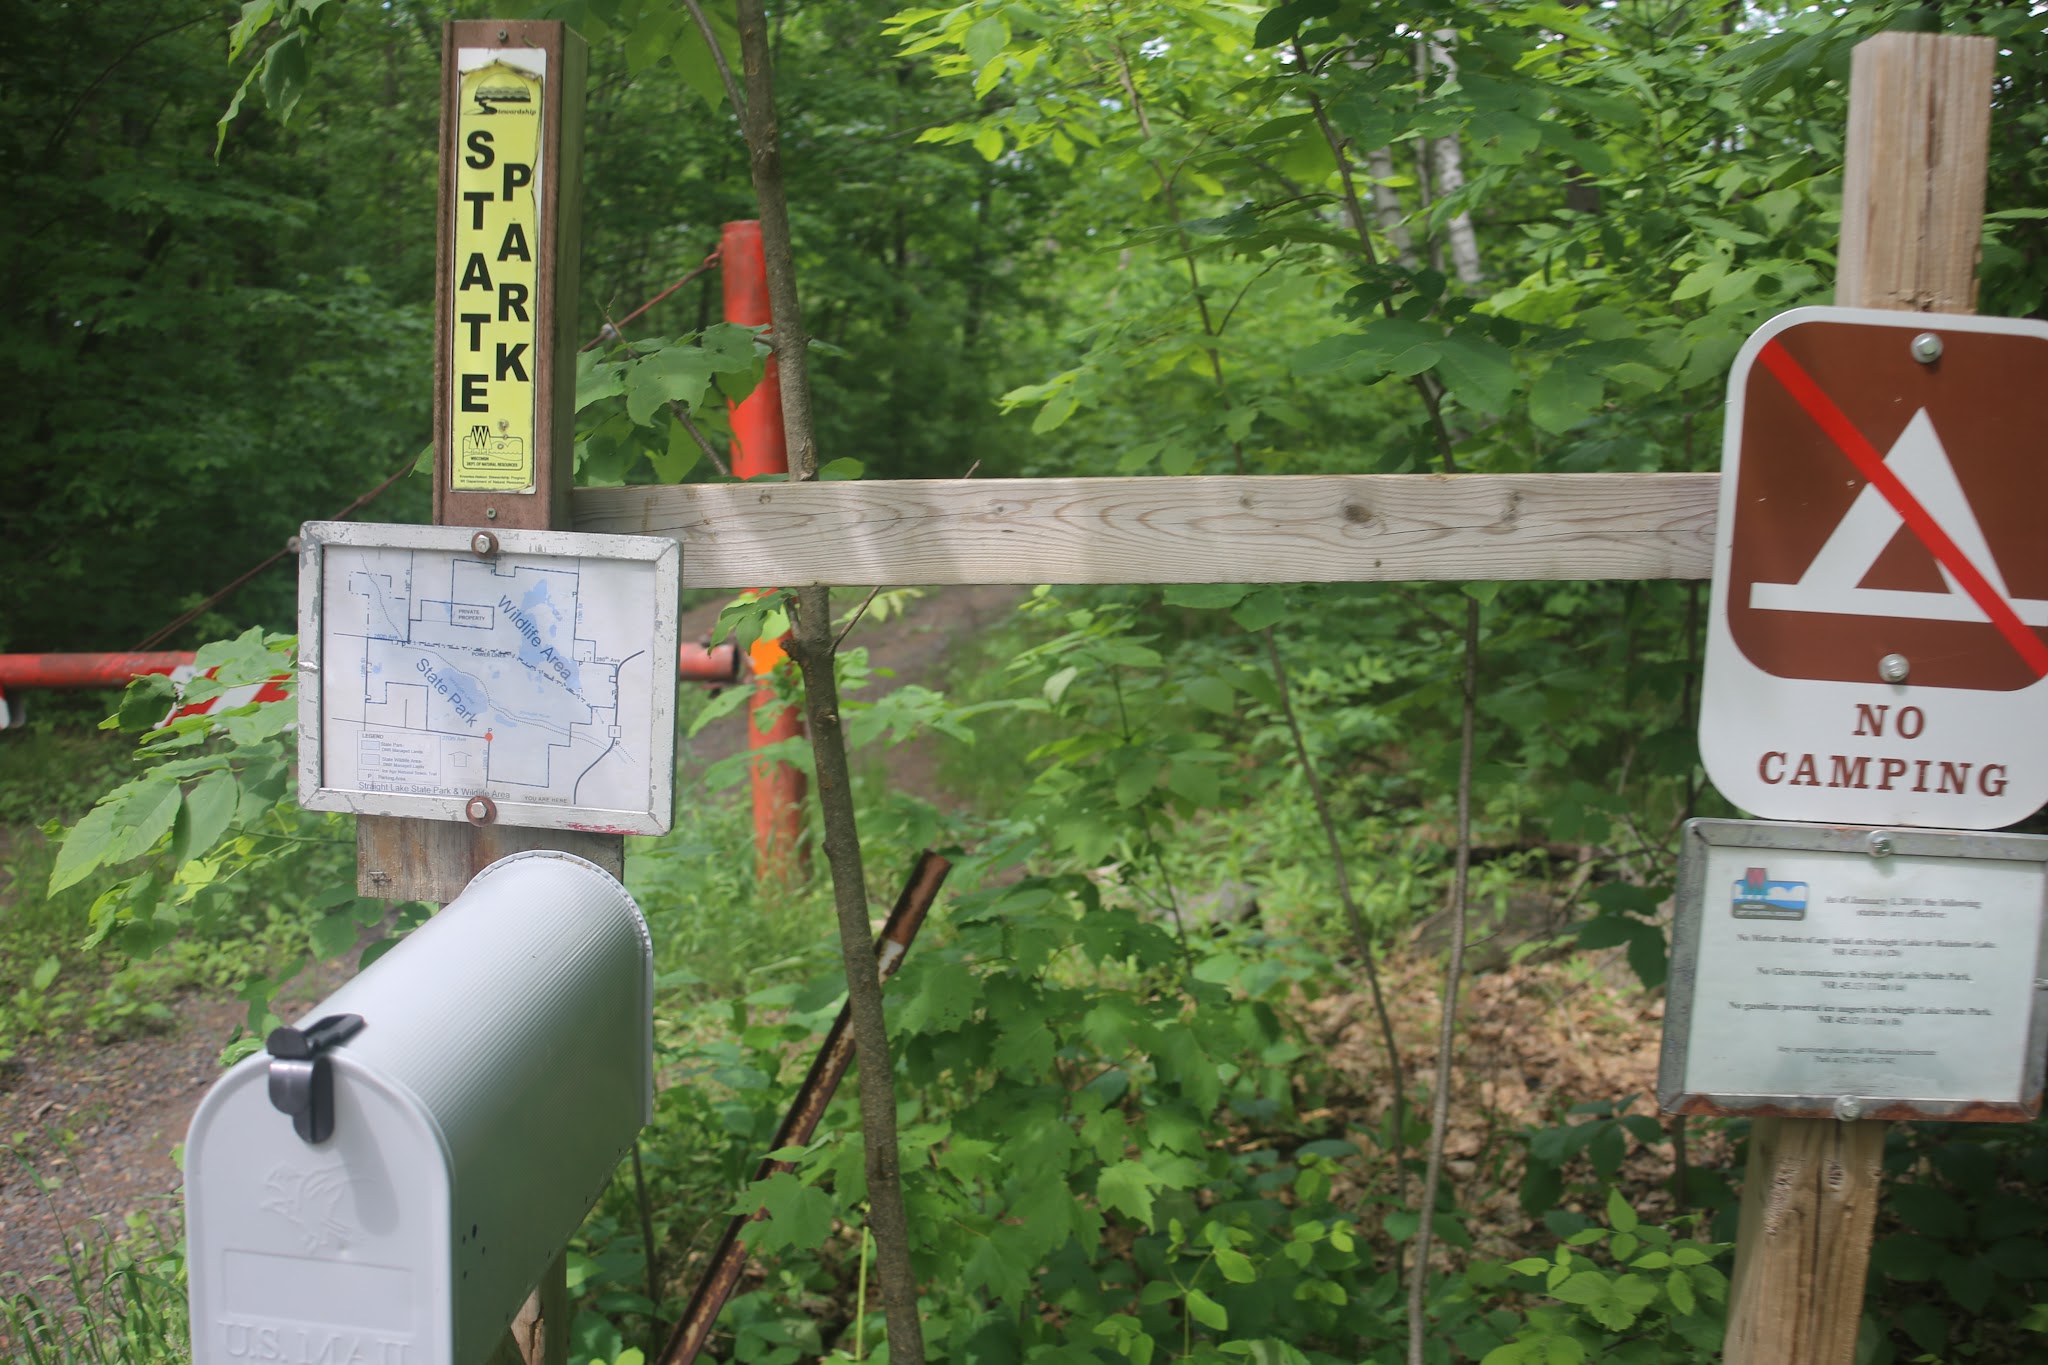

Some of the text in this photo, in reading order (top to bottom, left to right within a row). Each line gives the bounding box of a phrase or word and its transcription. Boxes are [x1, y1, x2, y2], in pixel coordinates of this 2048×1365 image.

[459, 130, 494, 413] STATE
[495, 163, 531, 382] PARK
[498, 595, 572, 681] Wildlife Area
[416, 658, 477, 728] State Park
[1853, 703, 1925, 739] NO
[358, 781, 388, 791] Straight
[390, 783, 409, 792] Lake
[411, 784, 431, 794] State
[434, 786, 451, 795] Park
[461, 788, 489, 797] Wildlife
[491, 790, 511, 799] Area
[1757, 751, 2010, 797] CAMPING
[217, 1320, 288, 1364] U.S.
